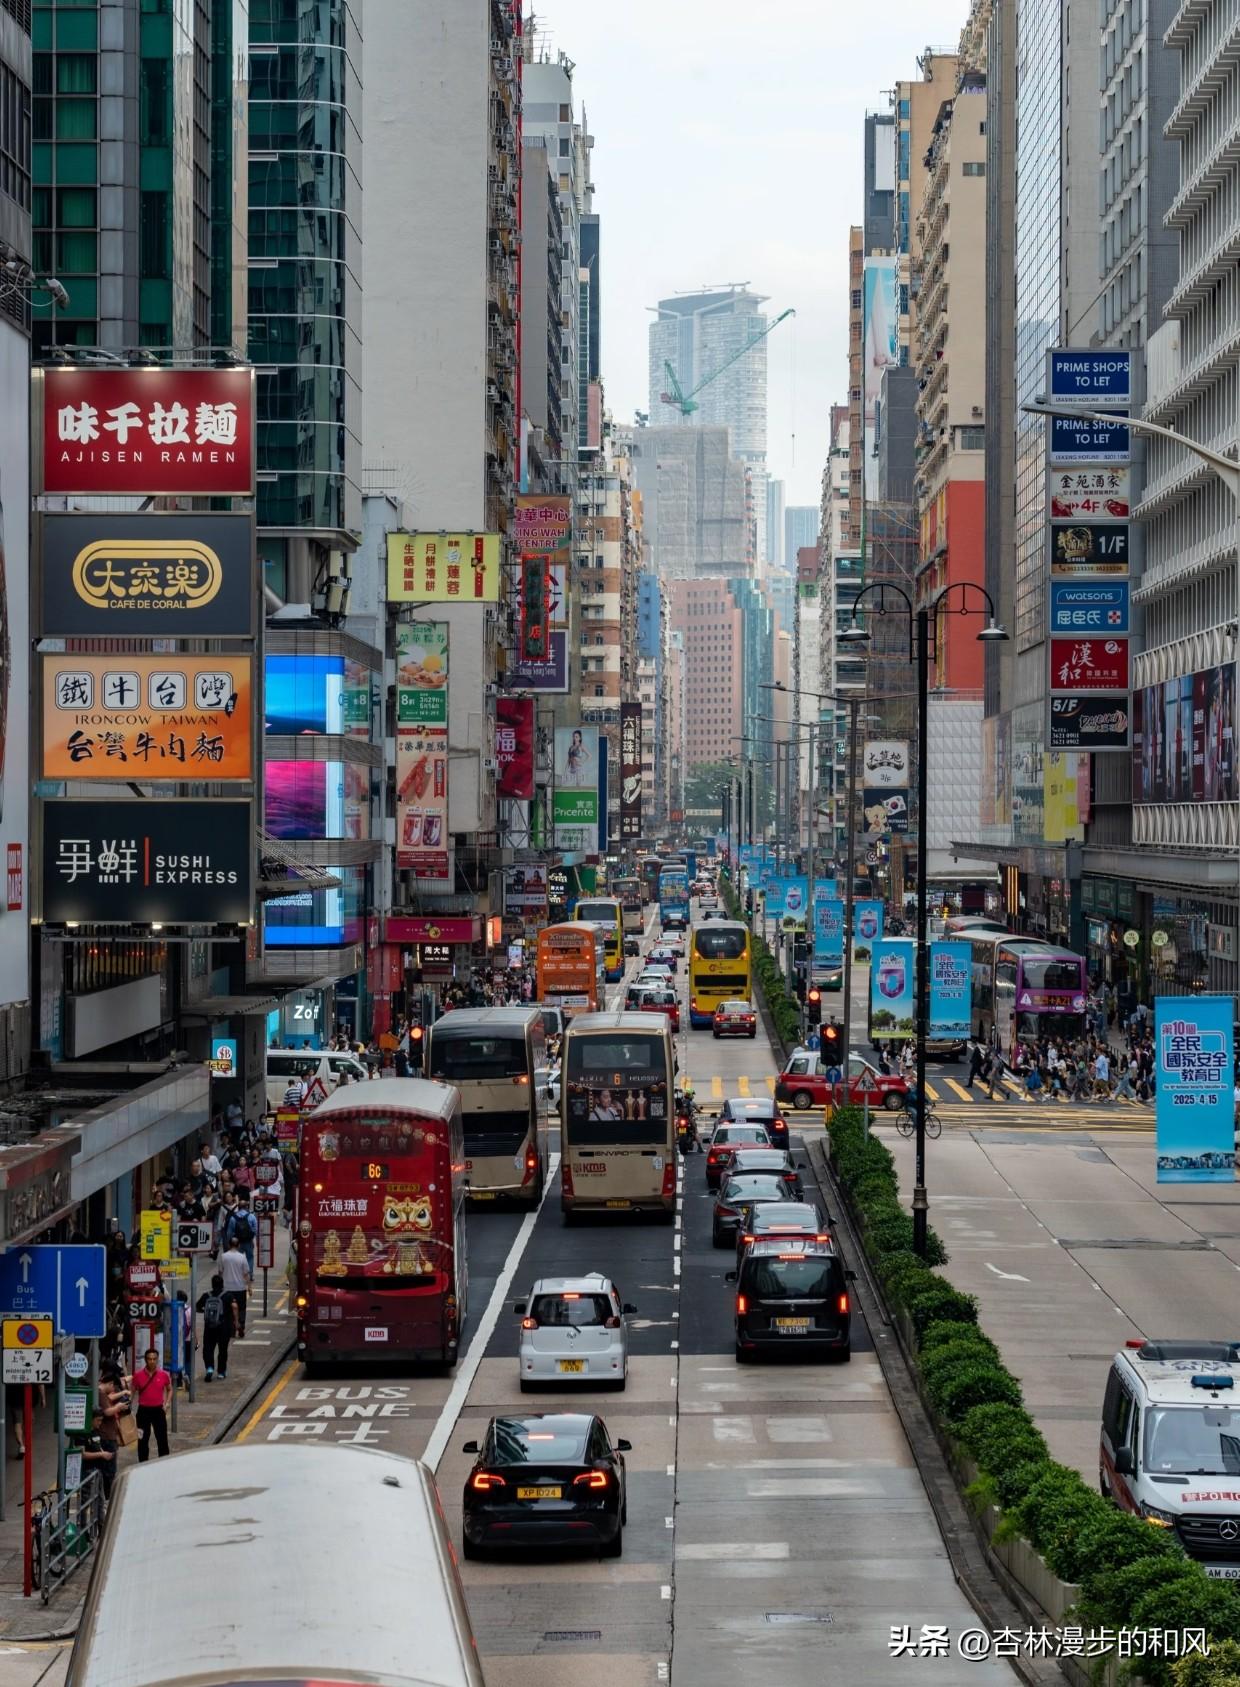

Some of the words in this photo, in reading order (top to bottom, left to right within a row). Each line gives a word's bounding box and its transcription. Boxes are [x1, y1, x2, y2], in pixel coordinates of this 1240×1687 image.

[1056, 362, 1089, 373] PRIME
[1093, 362, 1129, 373] SHOPS
[1076, 376, 1090, 387] TO
[1094, 376, 1110, 387] LET
[1056, 420, 1090, 430] PRIME
[1075, 433, 1090, 444] TO
[1094, 433, 1110, 444] LET
[61, 451, 142, 462] AJISEN
[161, 451, 235, 462] RAMEN
[1060, 475, 1120, 488] 金苑酒家
[540, 528, 565, 537] WAH
[518, 540, 558, 548] CENTRE
[1099, 535, 1125, 553] 1/F
[1066, 592, 1113, 601] watsons
[137, 599, 151, 609] DE
[152, 599, 186, 609] CORAL
[1057, 610, 1100, 624] 屈臣氏
[1052, 699, 1078, 712] 5/F
[75, 715, 152, 725] IRONCOW
[160, 715, 218, 725] TAIWAN
[155, 856, 210, 867] SUSHI
[155, 872, 238, 884] EXPRESS
[1171, 1036, 1200, 1051] 全民
[1166, 1052, 1228, 1067] 國家安全
[614, 1073, 621, 1085] 6
[1181, 1068, 1220, 1082] 教育日
[583, 1163, 606, 1172] KMB
[255, 1200, 276, 1210] S11
[318, 1199, 368, 1212] 六福珠寶
[13, 1298, 38, 1309] 巴士
[129, 1303, 157, 1316] S10
[34, 1351, 43, 1362] 7
[35, 1370, 50, 1381] 12
[295, 1387, 410, 1400] BUS
[269, 1403, 416, 1418] LANE
[1208, 1569, 1221, 1577] AM
